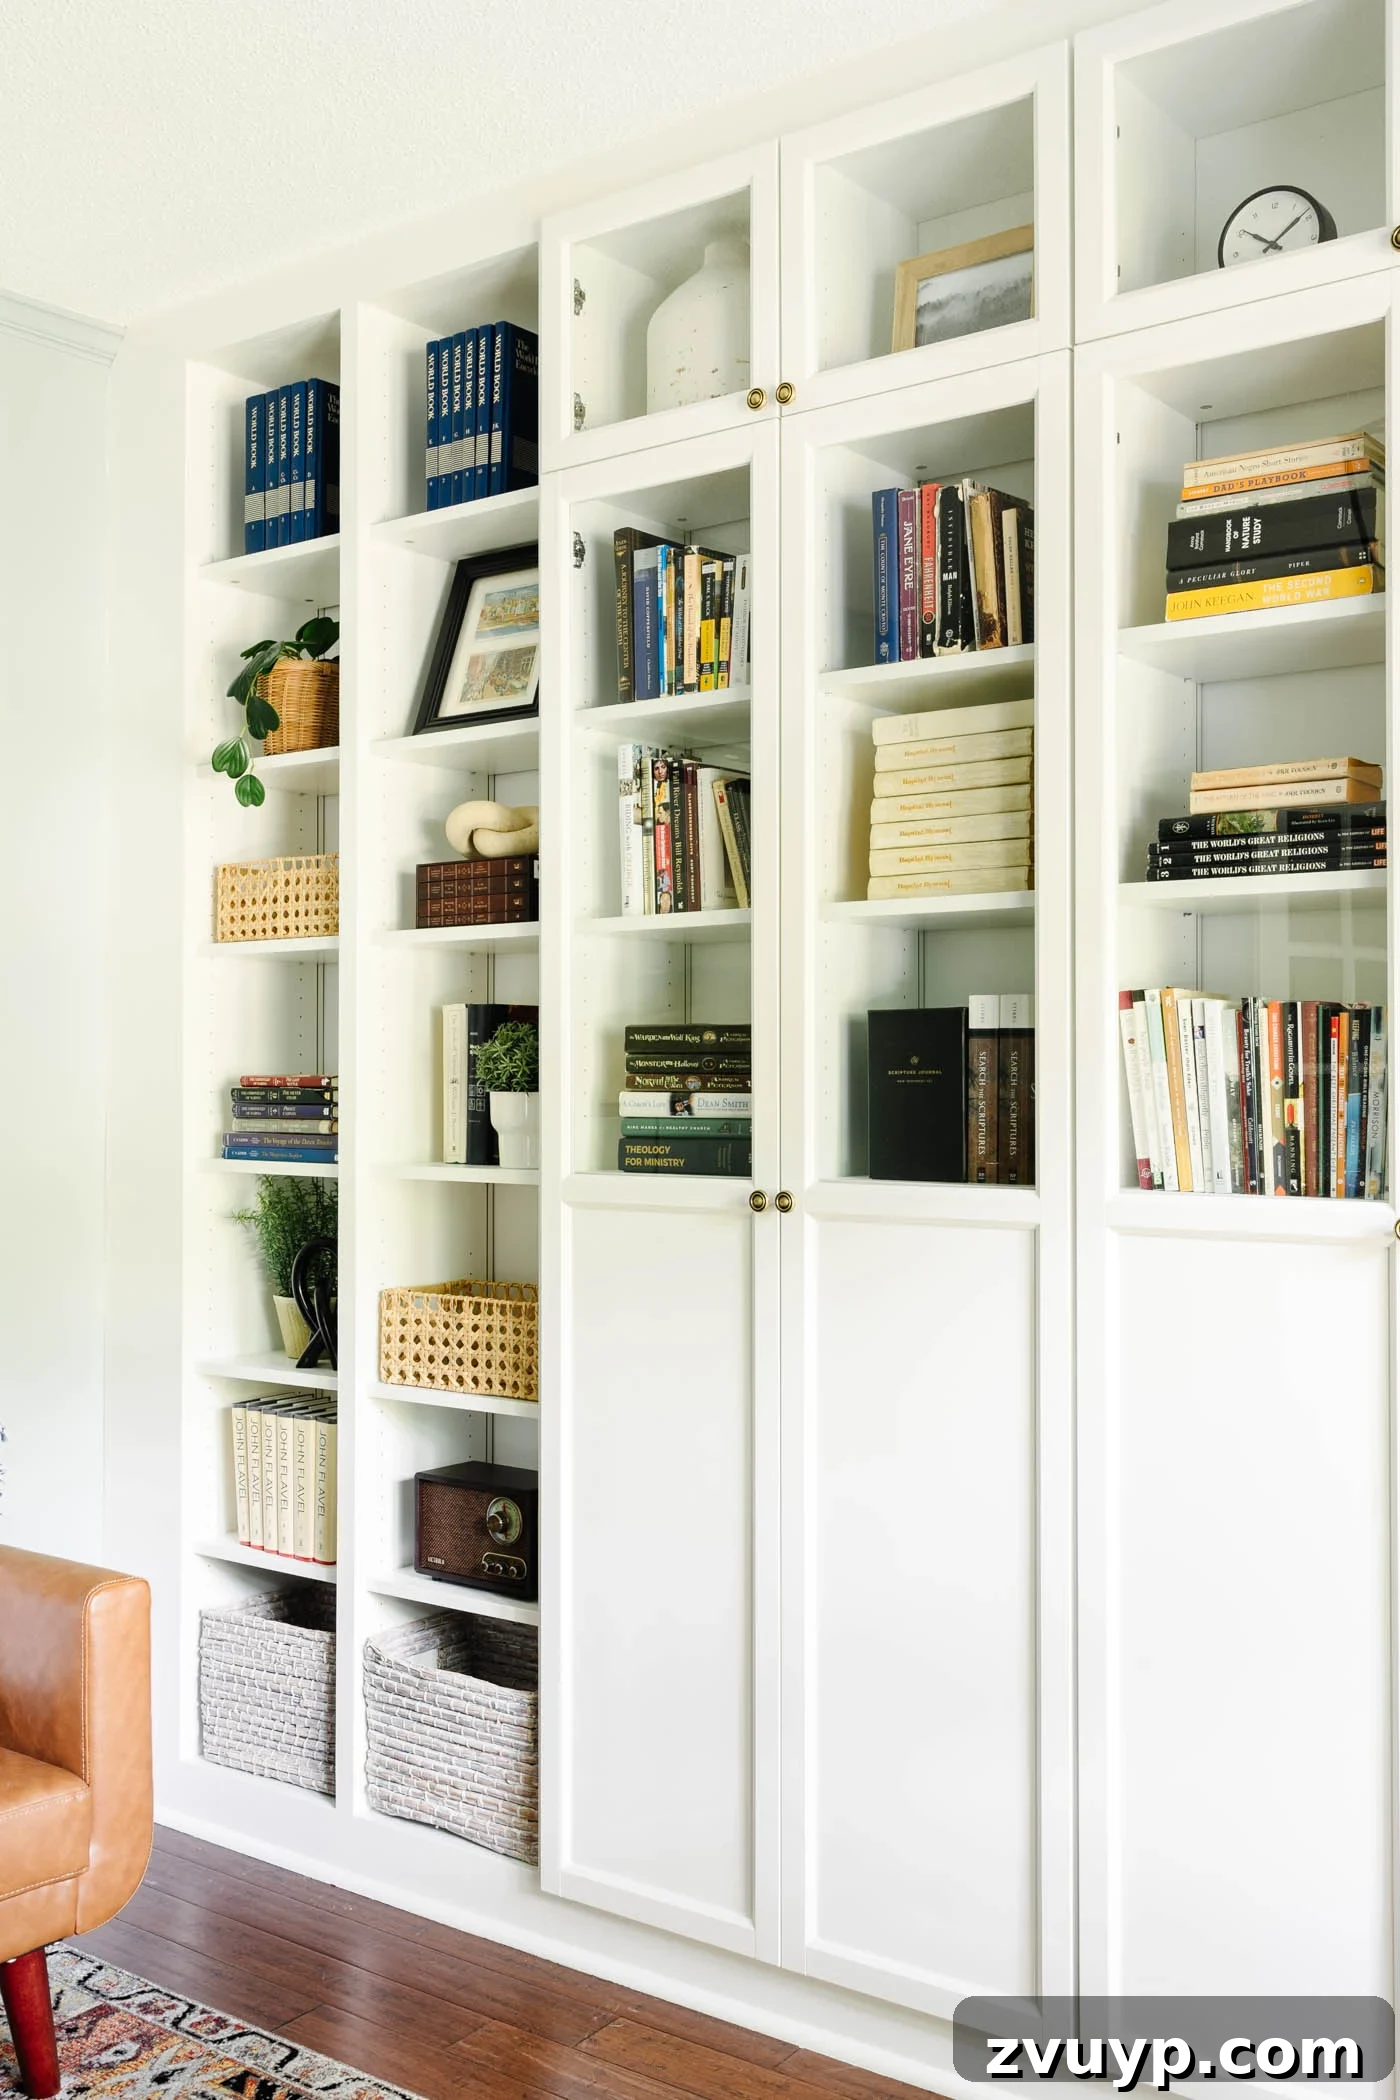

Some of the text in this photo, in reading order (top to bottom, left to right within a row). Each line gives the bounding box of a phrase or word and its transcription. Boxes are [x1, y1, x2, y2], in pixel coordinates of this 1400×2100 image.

[493, 334, 502, 403] WORLD BOOK
[1213, 481, 1245, 493] DAD'S
[1248, 471, 1307, 487] PLAYBOOK
[1242, 516, 1250, 549] NATURE
[1253, 518, 1262, 544] STUDY
[903, 521, 914, 590] JANE EYRE
[1288, 560, 1311, 568] PIPER
[923, 556, 934, 609] FAHRENHEIT
[942, 572, 958, 582] MAN
[1187, 571, 1227, 584] PECULIAR
[1230, 567, 1256, 579] GLORY
[1263, 575, 1332, 593] THE SECOND
[620, 570, 628, 606] JOURNEY
[1262, 588, 1331, 604] WORLD WAR
[1170, 592, 1254, 613] JOHN KEEGAN
[672, 771, 680, 784] Fall
[673, 787, 681, 806] River
[1191, 832, 1325, 849] THE WORLD'S GREAT RELIGIONS
[1371, 827, 1385, 836] LIFE
[675, 841, 683, 855] Bill
[1194, 846, 1328, 863] THE WORLD'S GREAT RELIGIONS
[675, 858, 683, 894] Reynolds
[1192, 861, 1326, 877] THE WORLD'S GREAT RELIGIONS
[1010, 1051, 1018, 1086] SEARCH
[697, 1099, 749, 1108] DEAN SMITH
[1370, 1091, 1380, 1138] MORRISON
[978, 1101, 986, 1156] SCRIPTURES
[1009, 1101, 1017, 1156] SCRIPTURES
[625, 1145, 671, 1154] THEOLOGY
[625, 1158, 685, 1167] FOR MINISTRY
[236, 1416, 246, 1501] JOHN FLAVEL
[250, 1418, 260, 1506] JOHN FLAVEL
[280, 1425, 288, 1512] JOHN FLAVEL
[297, 1426, 305, 1516] JOHN FLAVEL
[318, 1430, 327, 1519] JOHN FLAVEL
[265, 1462, 273, 1510] FLAVEL
